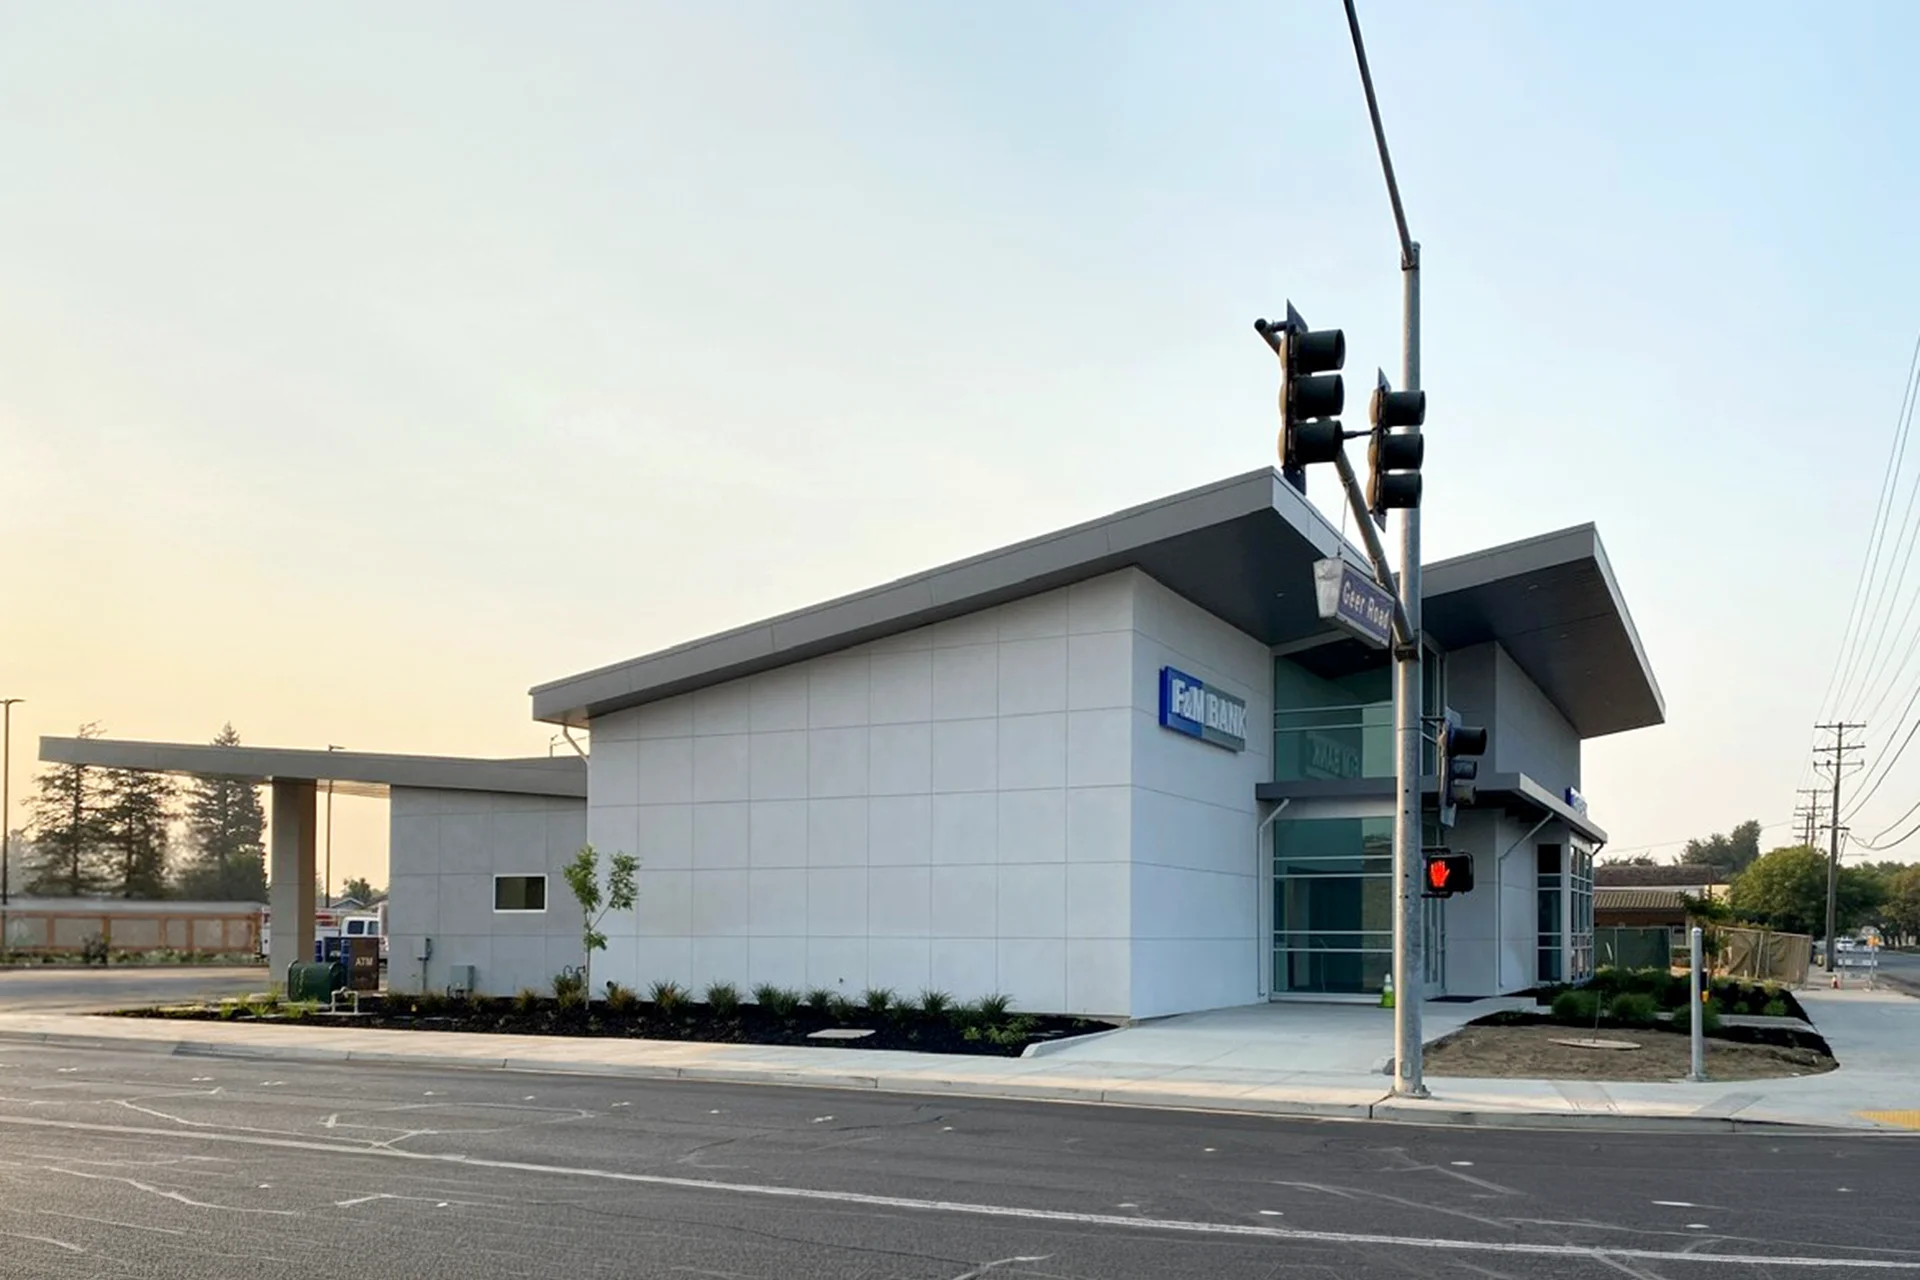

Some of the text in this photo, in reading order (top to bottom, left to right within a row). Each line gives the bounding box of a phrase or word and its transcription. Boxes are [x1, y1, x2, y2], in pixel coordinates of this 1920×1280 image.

[1342, 580, 1391, 630] Geer Road
[1171, 679, 1247, 739] F&M BANK
[355, 956, 374, 967] ATM
